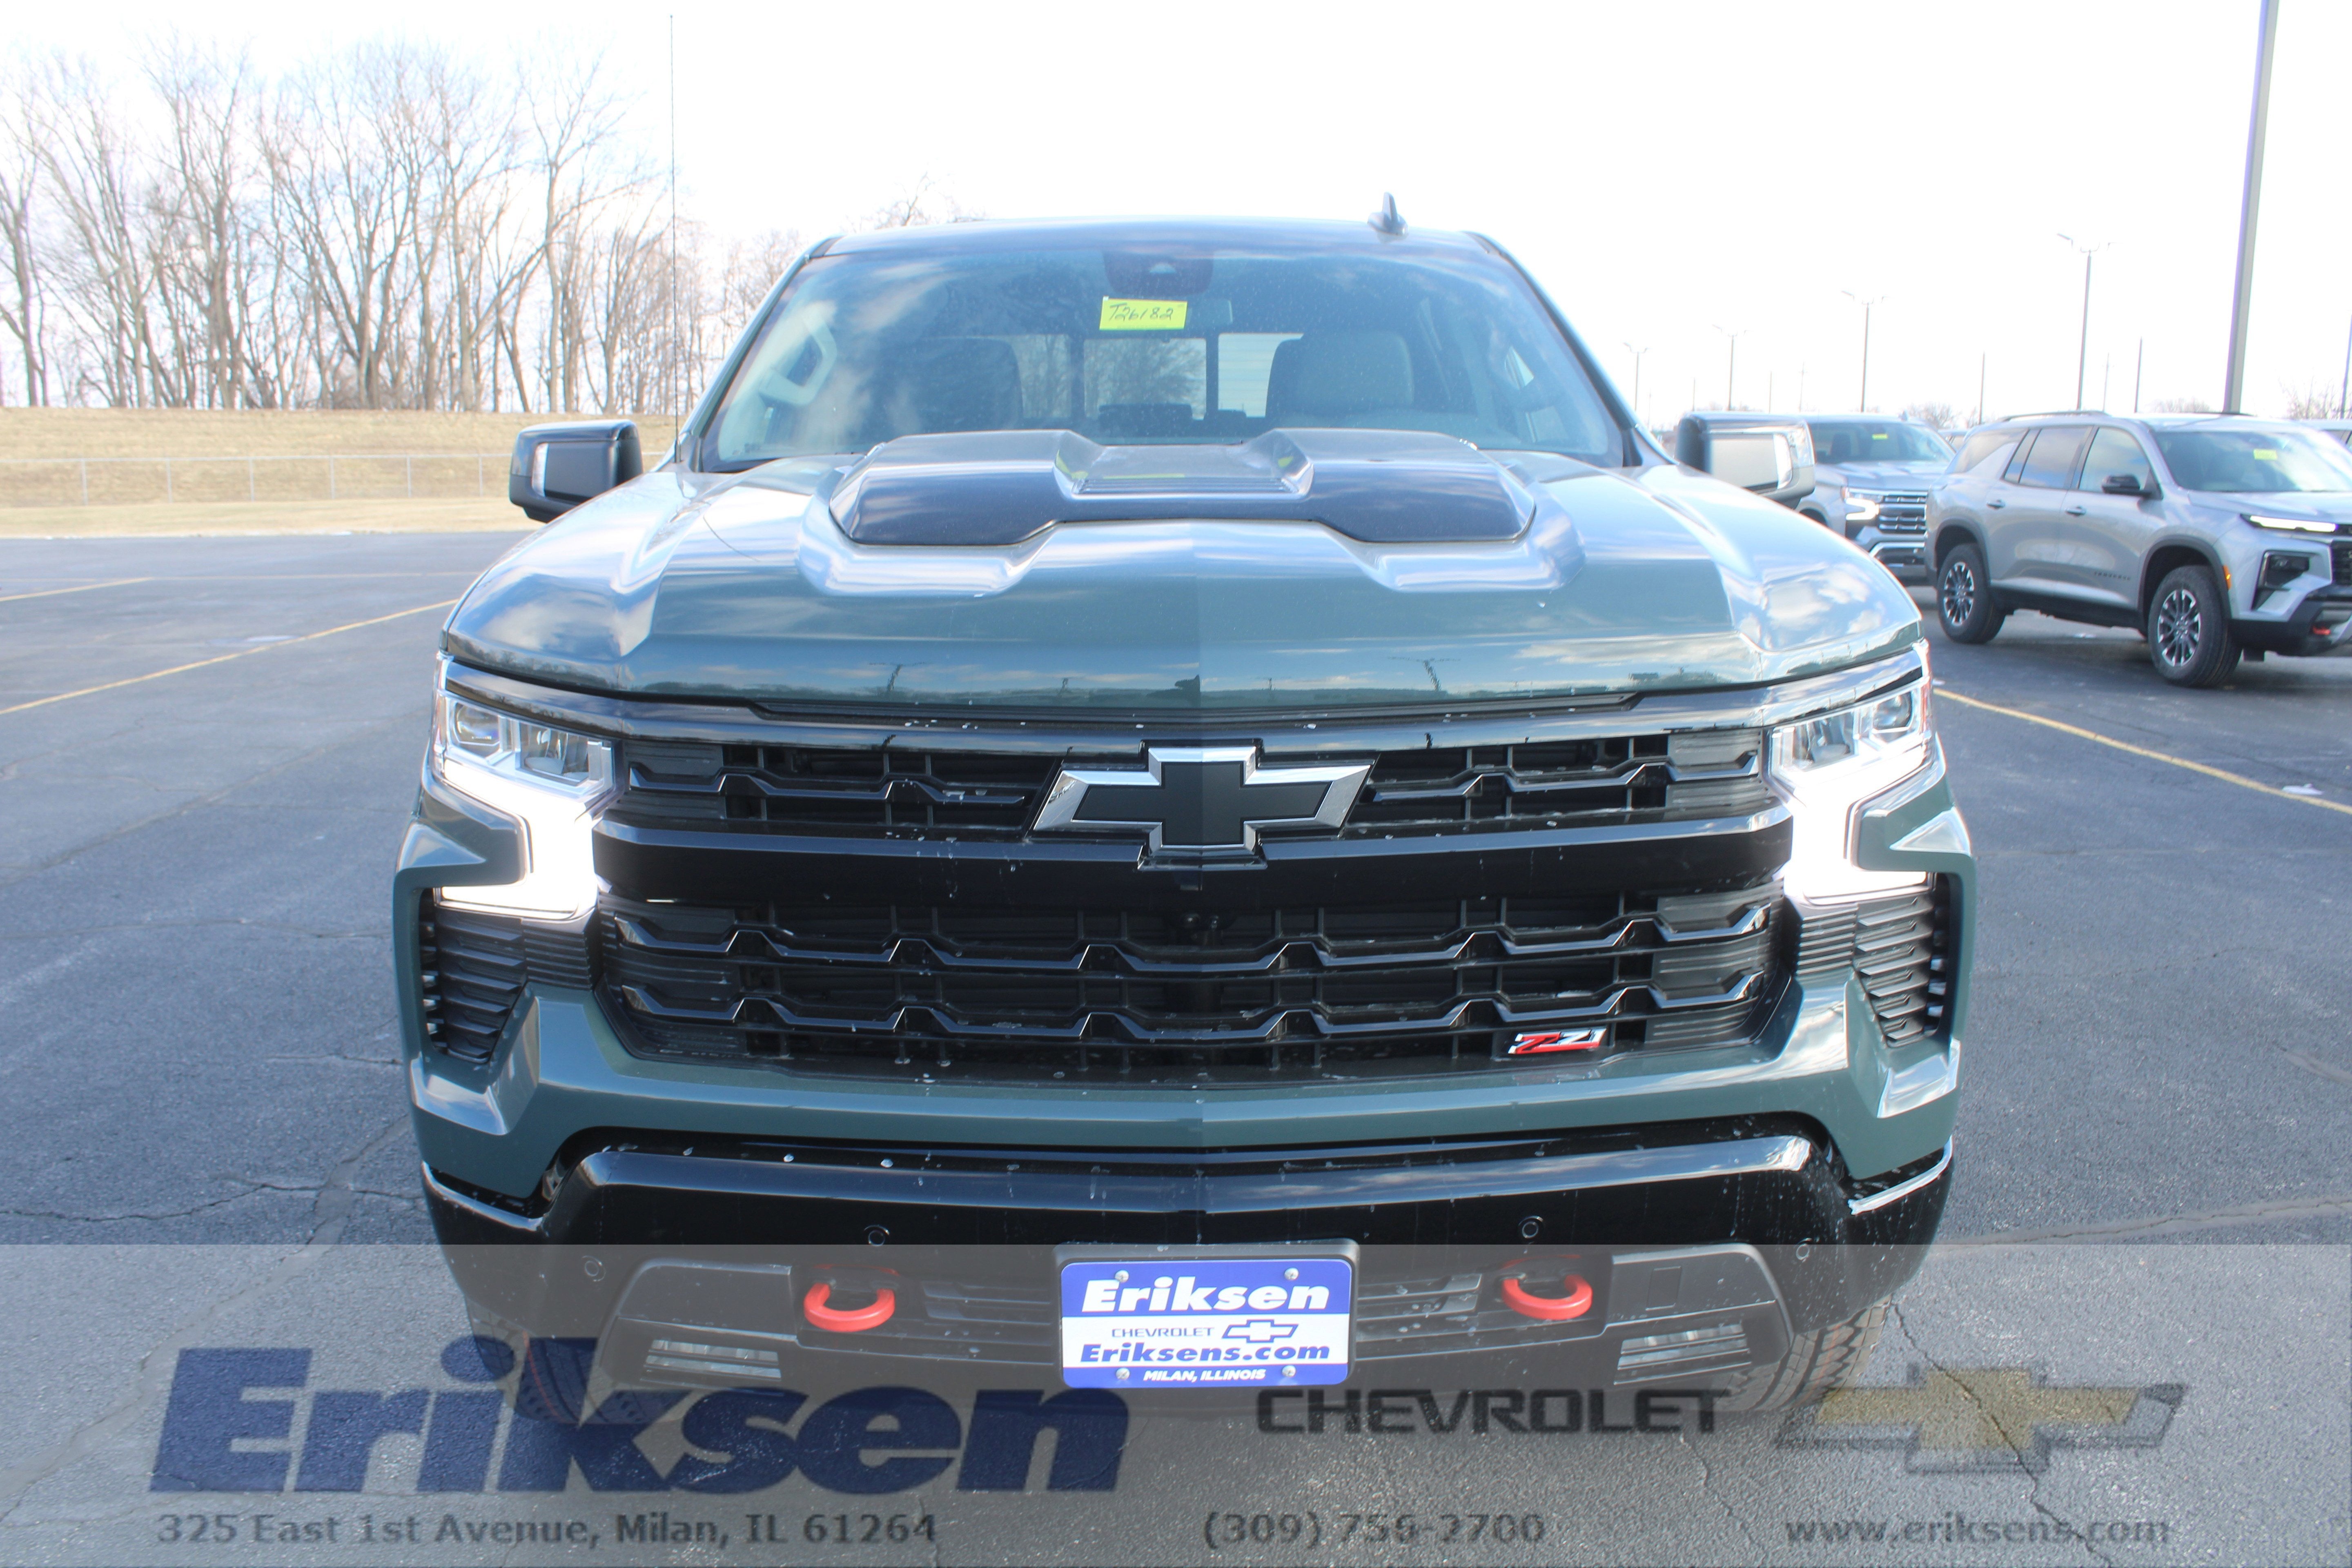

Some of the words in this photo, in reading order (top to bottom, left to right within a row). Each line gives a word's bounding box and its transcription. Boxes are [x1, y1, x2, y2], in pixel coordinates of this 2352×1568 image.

[1508, 1028, 1607, 1054] Z71
[1082, 1276, 1330, 1312] Eriksen
[1111, 1327, 1214, 1337] CHEVROLET
[1080, 1341, 1330, 1362] Eriksens.com
[1143, 1370, 1198, 1383] MILAN,
[1200, 1369, 1266, 1381] ILLINOIS
